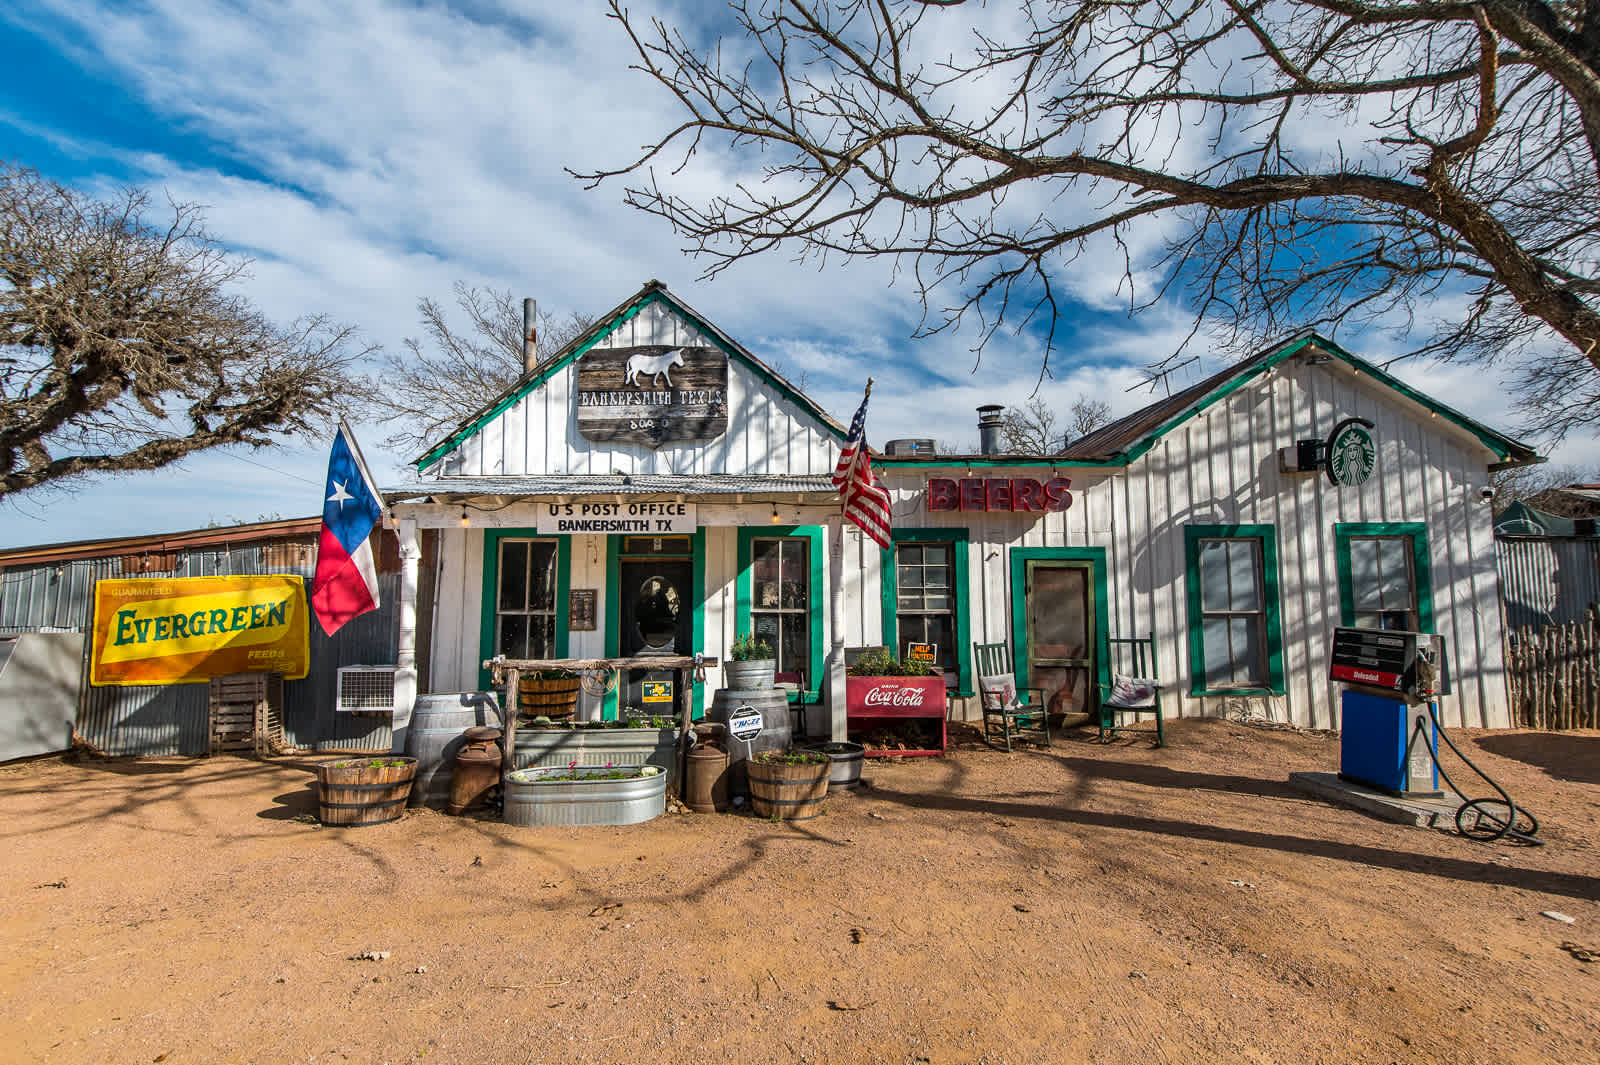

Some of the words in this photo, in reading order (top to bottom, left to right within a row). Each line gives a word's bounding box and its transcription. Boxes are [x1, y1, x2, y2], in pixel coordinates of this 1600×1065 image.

[928, 477, 1073, 512] BEERS
[549, 503, 559, 516] U
[565, 503, 574, 516] S
[582, 503, 620, 516] POST
[628, 503, 686, 516] OFFICE
[558, 519, 649, 532] BANKERSMITH
[655, 519, 672, 532] TX
[1353, 671, 1379, 682] Unleaded
